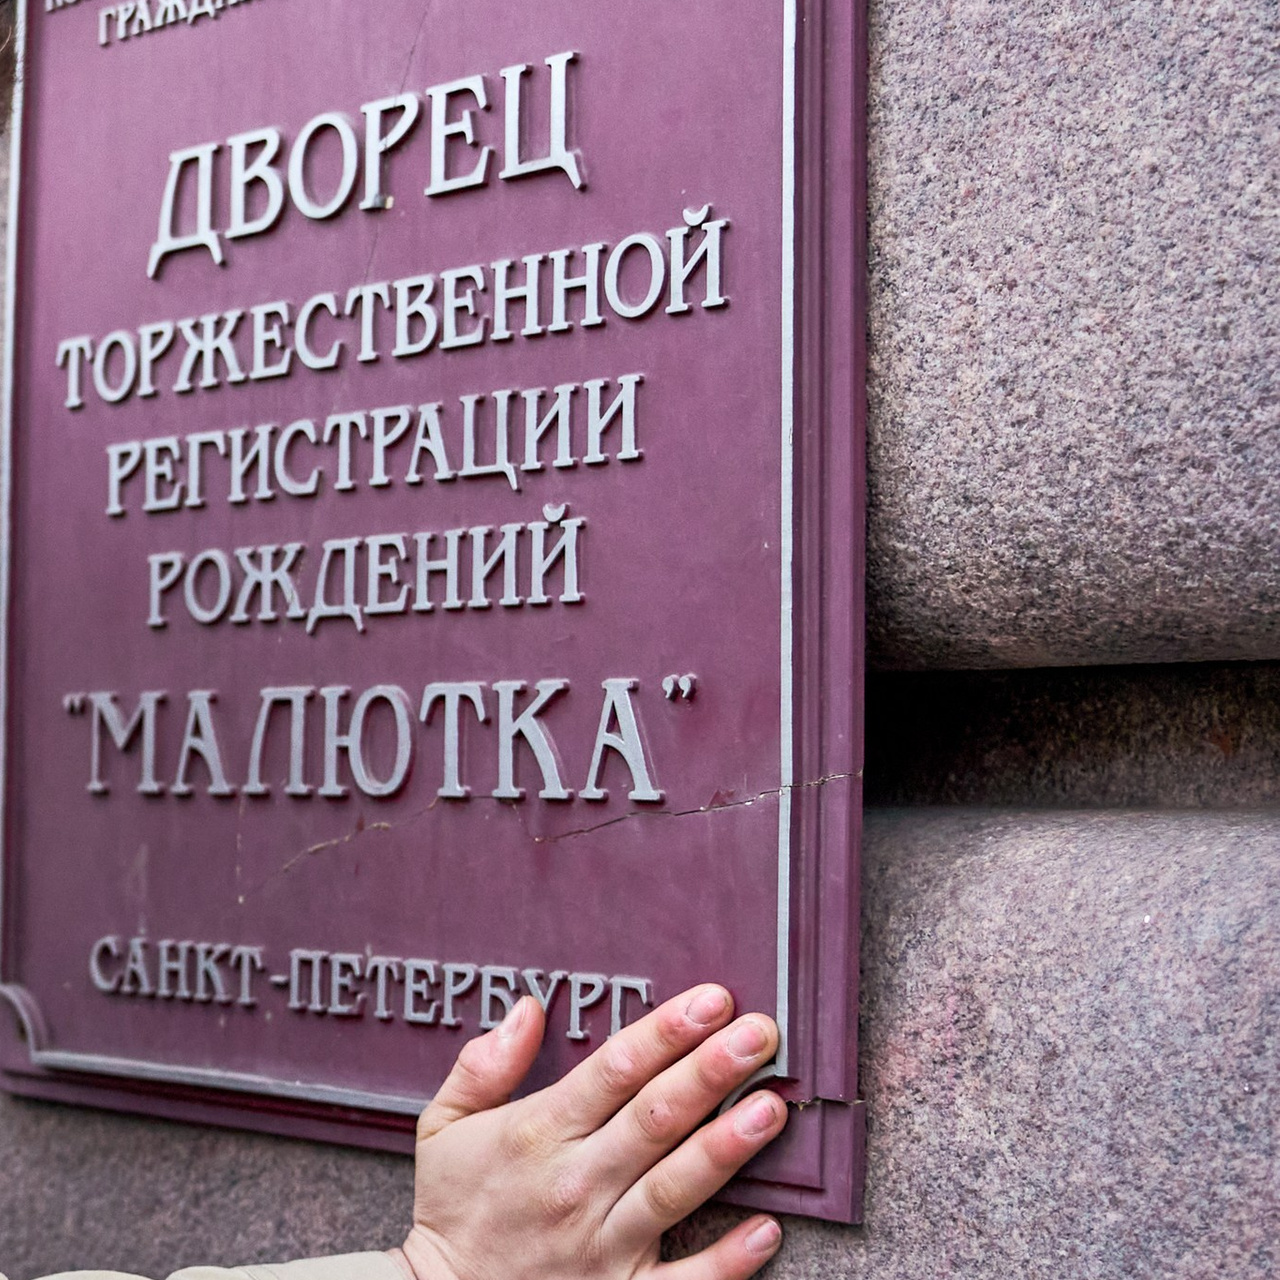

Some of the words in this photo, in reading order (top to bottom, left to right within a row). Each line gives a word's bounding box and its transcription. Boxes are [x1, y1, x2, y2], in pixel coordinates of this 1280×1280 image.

[147, 50, 588, 278] ДВОРЕЦ
[55, 204, 730, 409] ТОРЖЕСТВЕННОЙ
[106, 373, 645, 516] РЕГИСТРАЦИИ
[146, 502, 587, 634] РОЖДЕНИЙ
